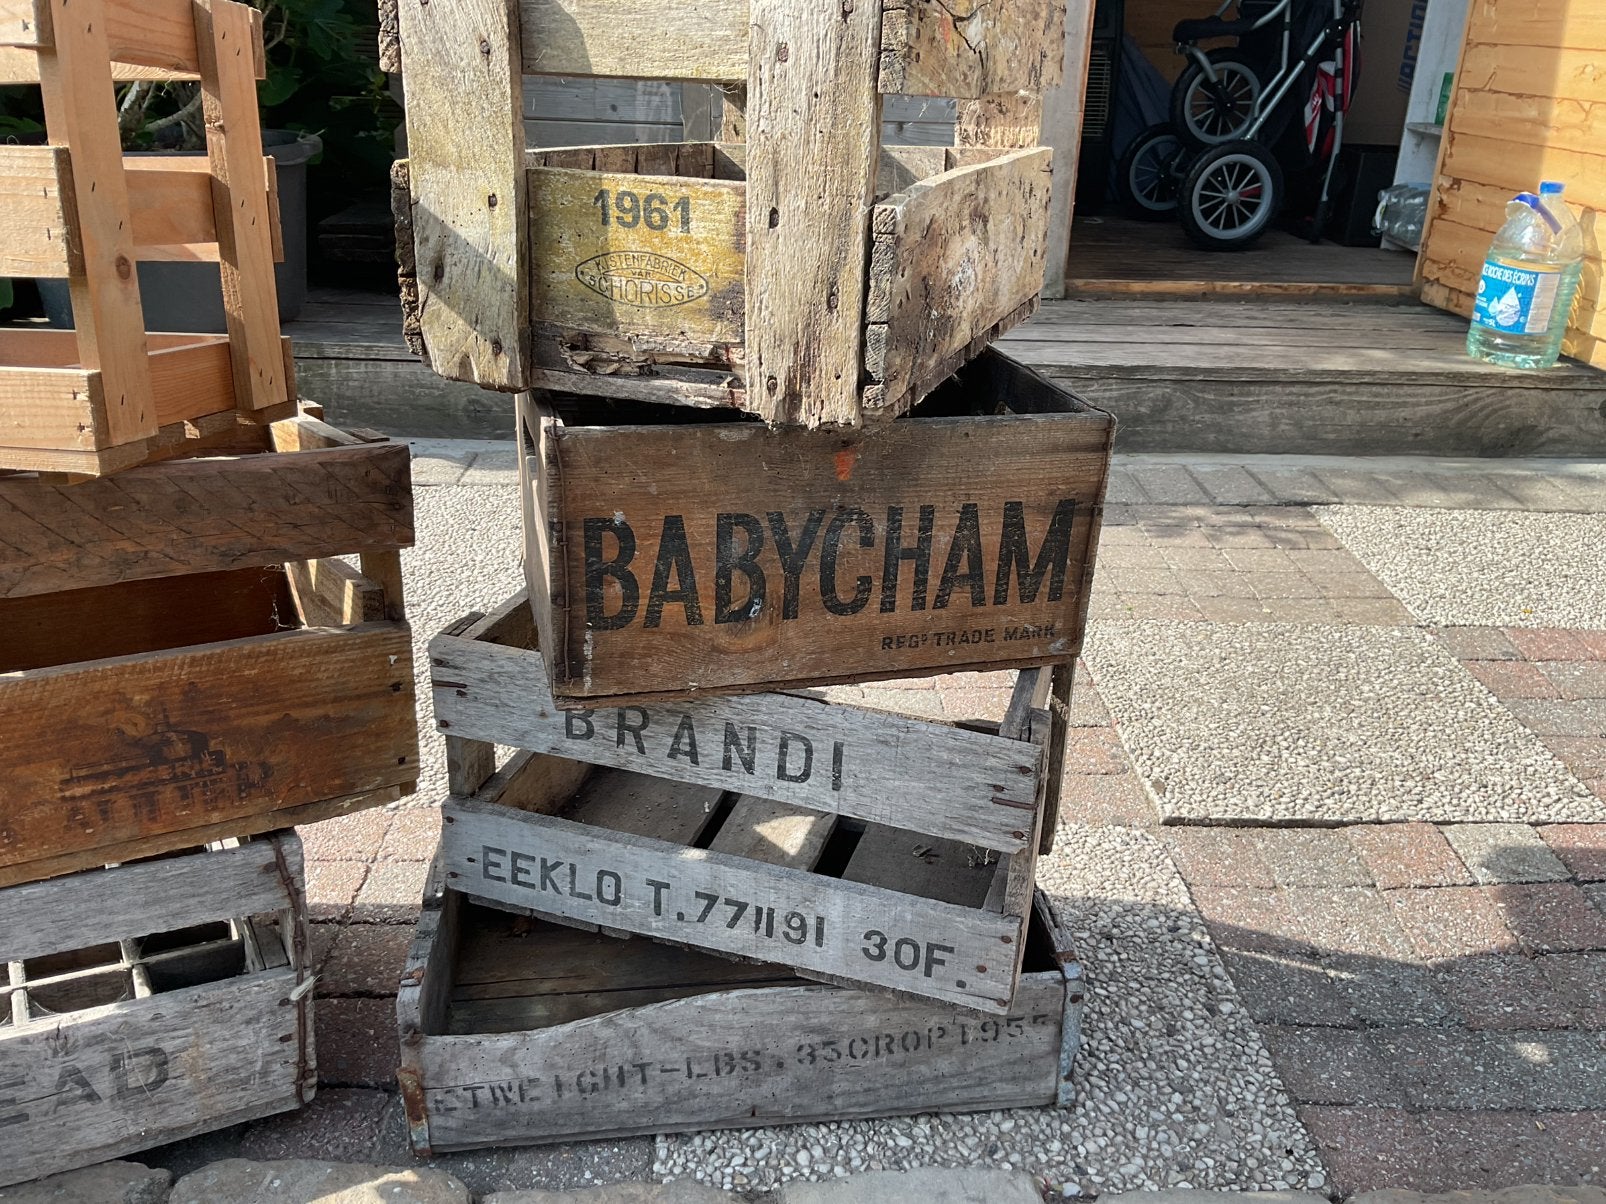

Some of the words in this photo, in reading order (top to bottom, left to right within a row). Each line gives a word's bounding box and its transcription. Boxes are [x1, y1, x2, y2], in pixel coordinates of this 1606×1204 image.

[1398, 0, 1428, 82] ACTIO
[592, 187, 691, 234] 1961
[588, 275, 695, 305] SCHORISSE
[594, 253, 688, 281] KISTENFABRIEK
[631, 269, 652, 278] VAN
[583, 499, 1076, 631] BABYCHAM
[933, 628, 996, 647] TRADE
[1003, 624, 1056, 642] MARK
[565, 705, 845, 792] BRANDI
[482, 844, 622, 906] EEKLO
